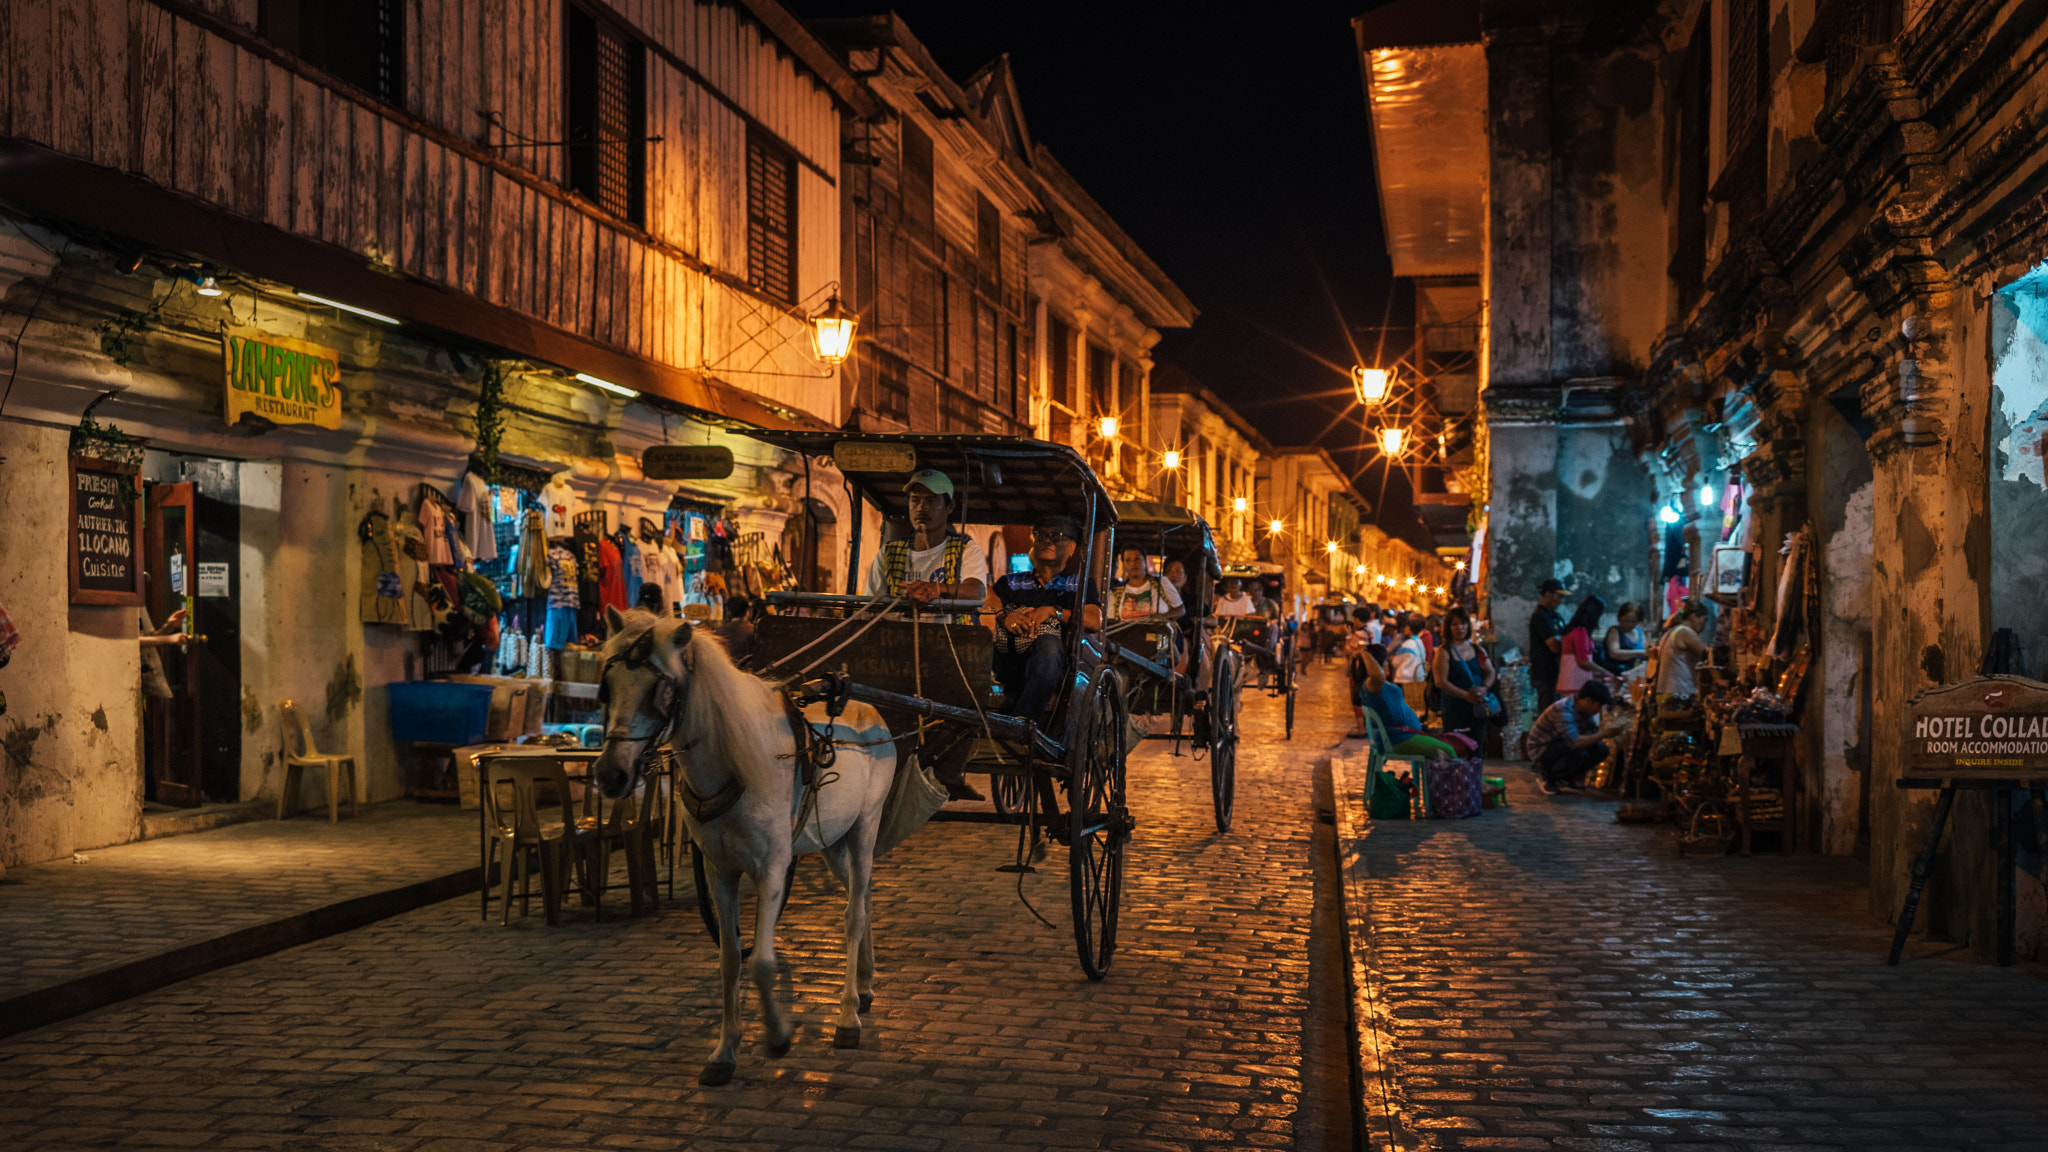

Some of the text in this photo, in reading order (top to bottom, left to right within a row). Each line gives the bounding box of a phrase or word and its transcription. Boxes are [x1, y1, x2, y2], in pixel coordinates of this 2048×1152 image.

[256, 396, 317, 422] RESTAURANT
[83, 556, 126, 578] Cuisine
[1915, 716, 1974, 738] HOTEL
[1926, 741, 1958, 754] ROOM
[1955, 758, 2024, 767] INQUIRE INSIDE
